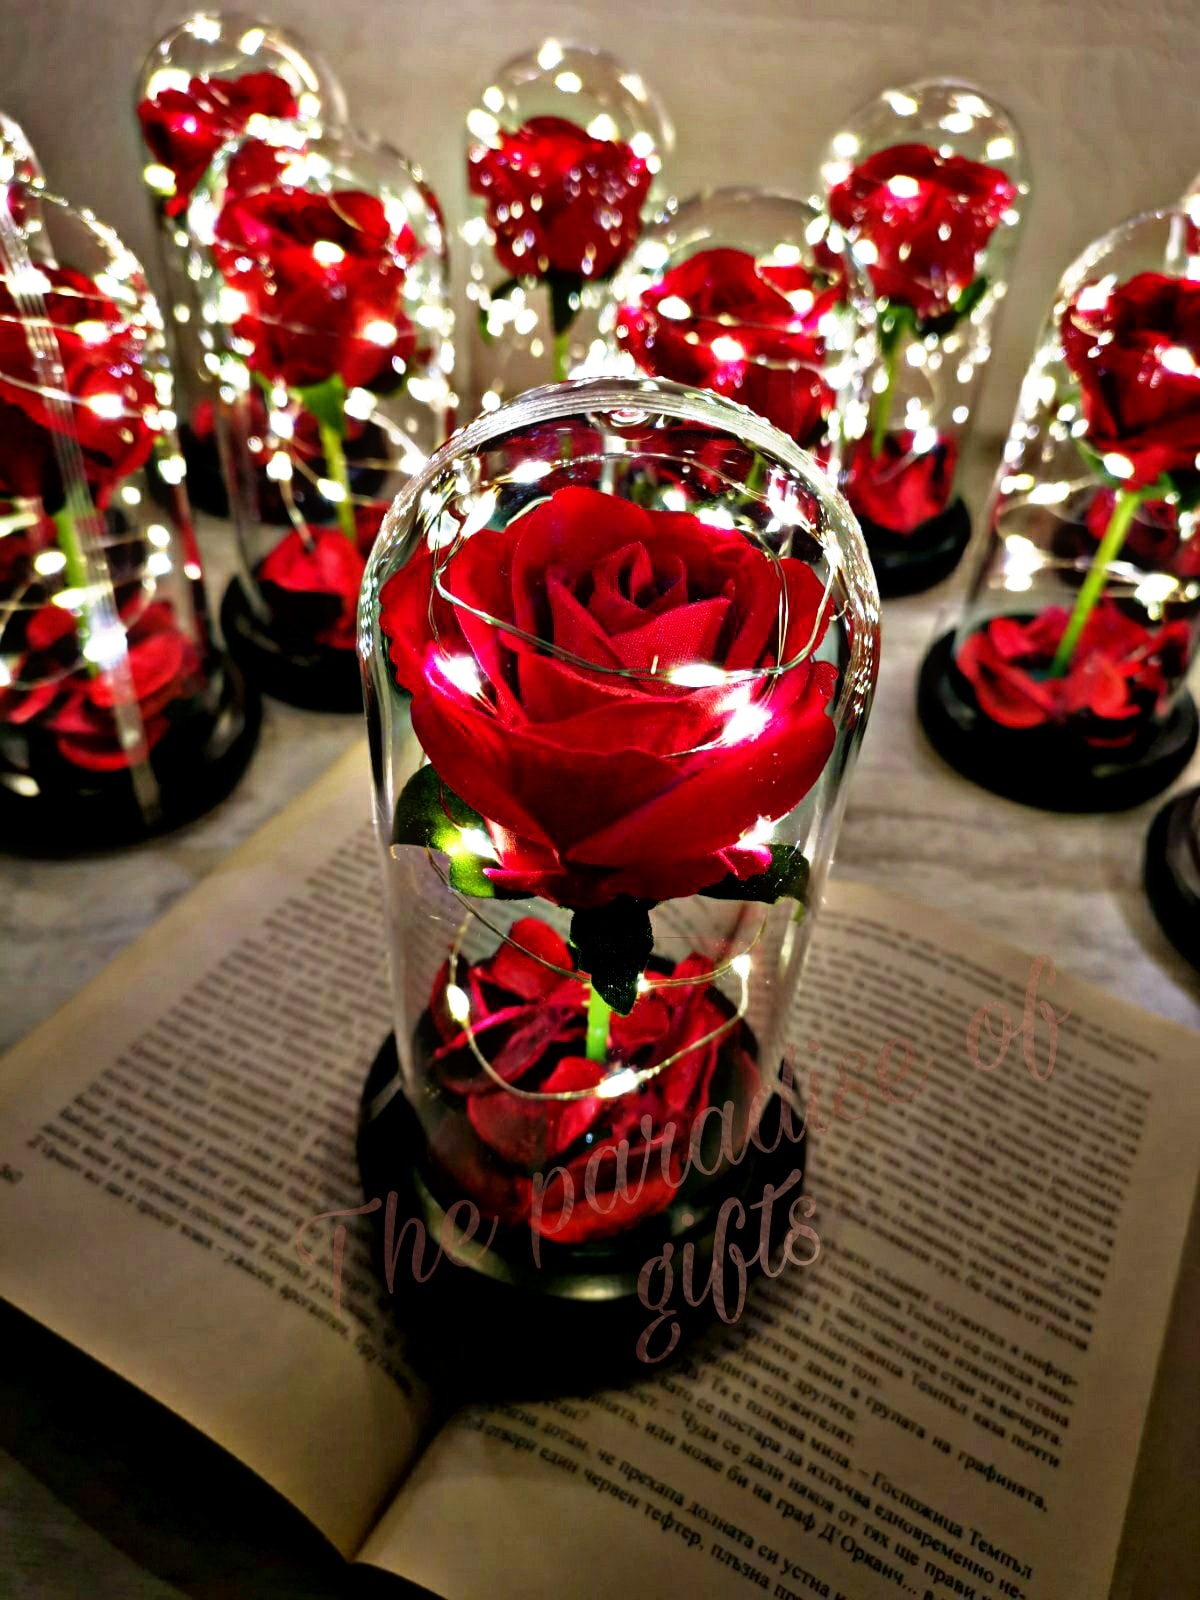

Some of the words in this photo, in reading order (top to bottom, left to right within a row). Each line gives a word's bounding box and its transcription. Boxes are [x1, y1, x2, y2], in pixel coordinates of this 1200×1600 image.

[871, 1471, 964, 1540] Госпожица
[969, 1529, 1033, 1580] Темпъл
[873, 1503, 995, 1584] едновременно
[923, 1560, 977, 1600] прави
